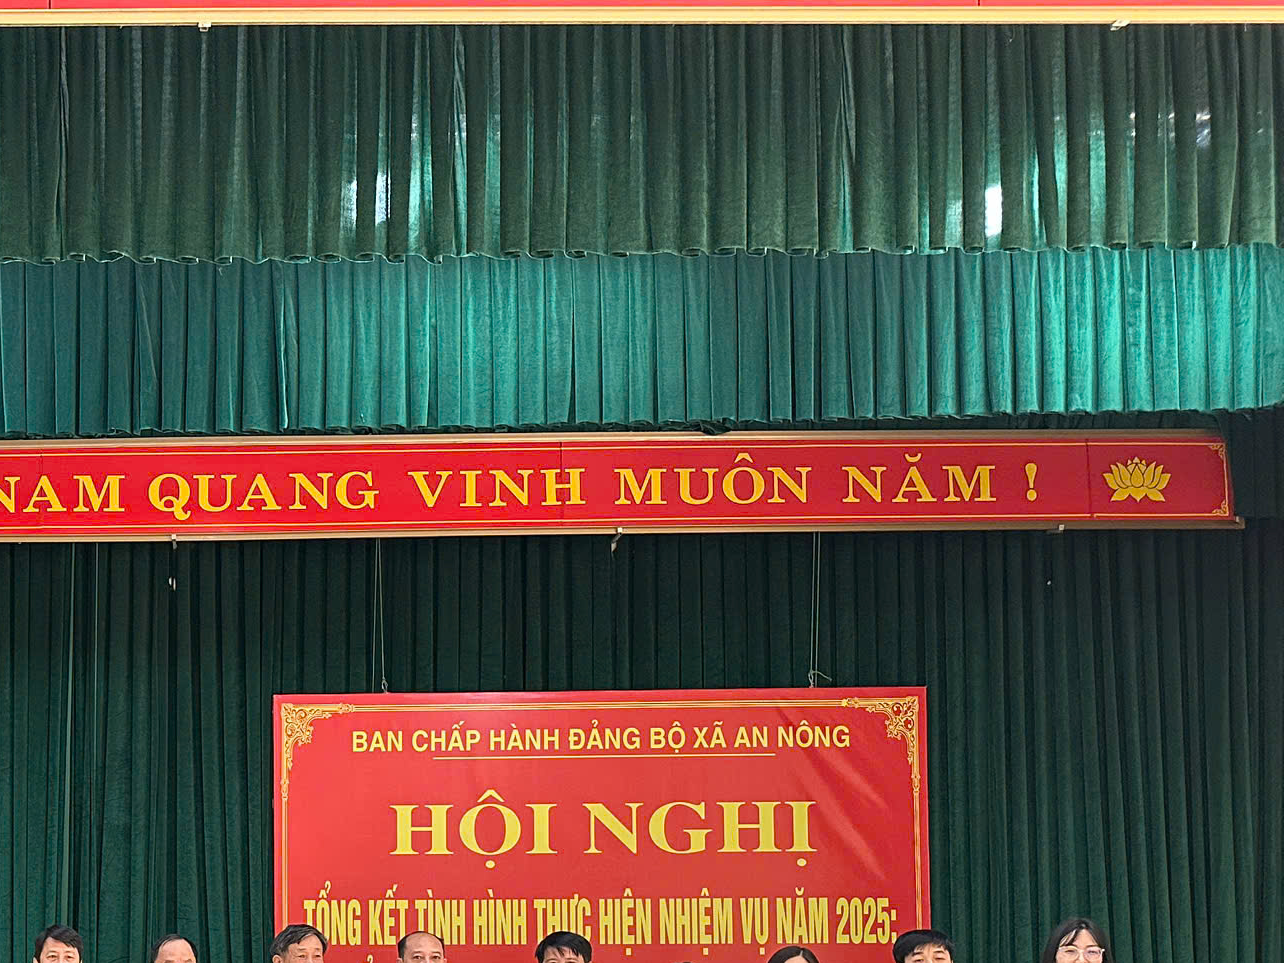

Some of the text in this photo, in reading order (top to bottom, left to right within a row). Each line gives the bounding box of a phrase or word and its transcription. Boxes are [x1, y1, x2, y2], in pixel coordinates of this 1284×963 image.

[147, 470, 377, 519] QUANG
[407, 467, 587, 508] VINH
[612, 454, 814, 507] MUÔN
[842, 453, 997, 503] NĂM
[1024, 462, 1039, 501] !
[351, 718, 851, 757] BAN CHẤP HÀNH ĐẢNG BỘ XÃ AN NÔNG
[389, 789, 818, 869] HỘI NGHỊ
[303, 880, 362, 946] TỔNG
[367, 884, 409, 946] KẾT
[414, 889, 466, 945] TÌNH
[473, 889, 527, 945] HÌNH
[598, 887, 653, 956] HIỆN
[659, 887, 734, 956] NHIỆM
[740, 897, 769, 956] VỤ
[776, 886, 829, 945] NĂM
[835, 897, 898, 945] 2025:
